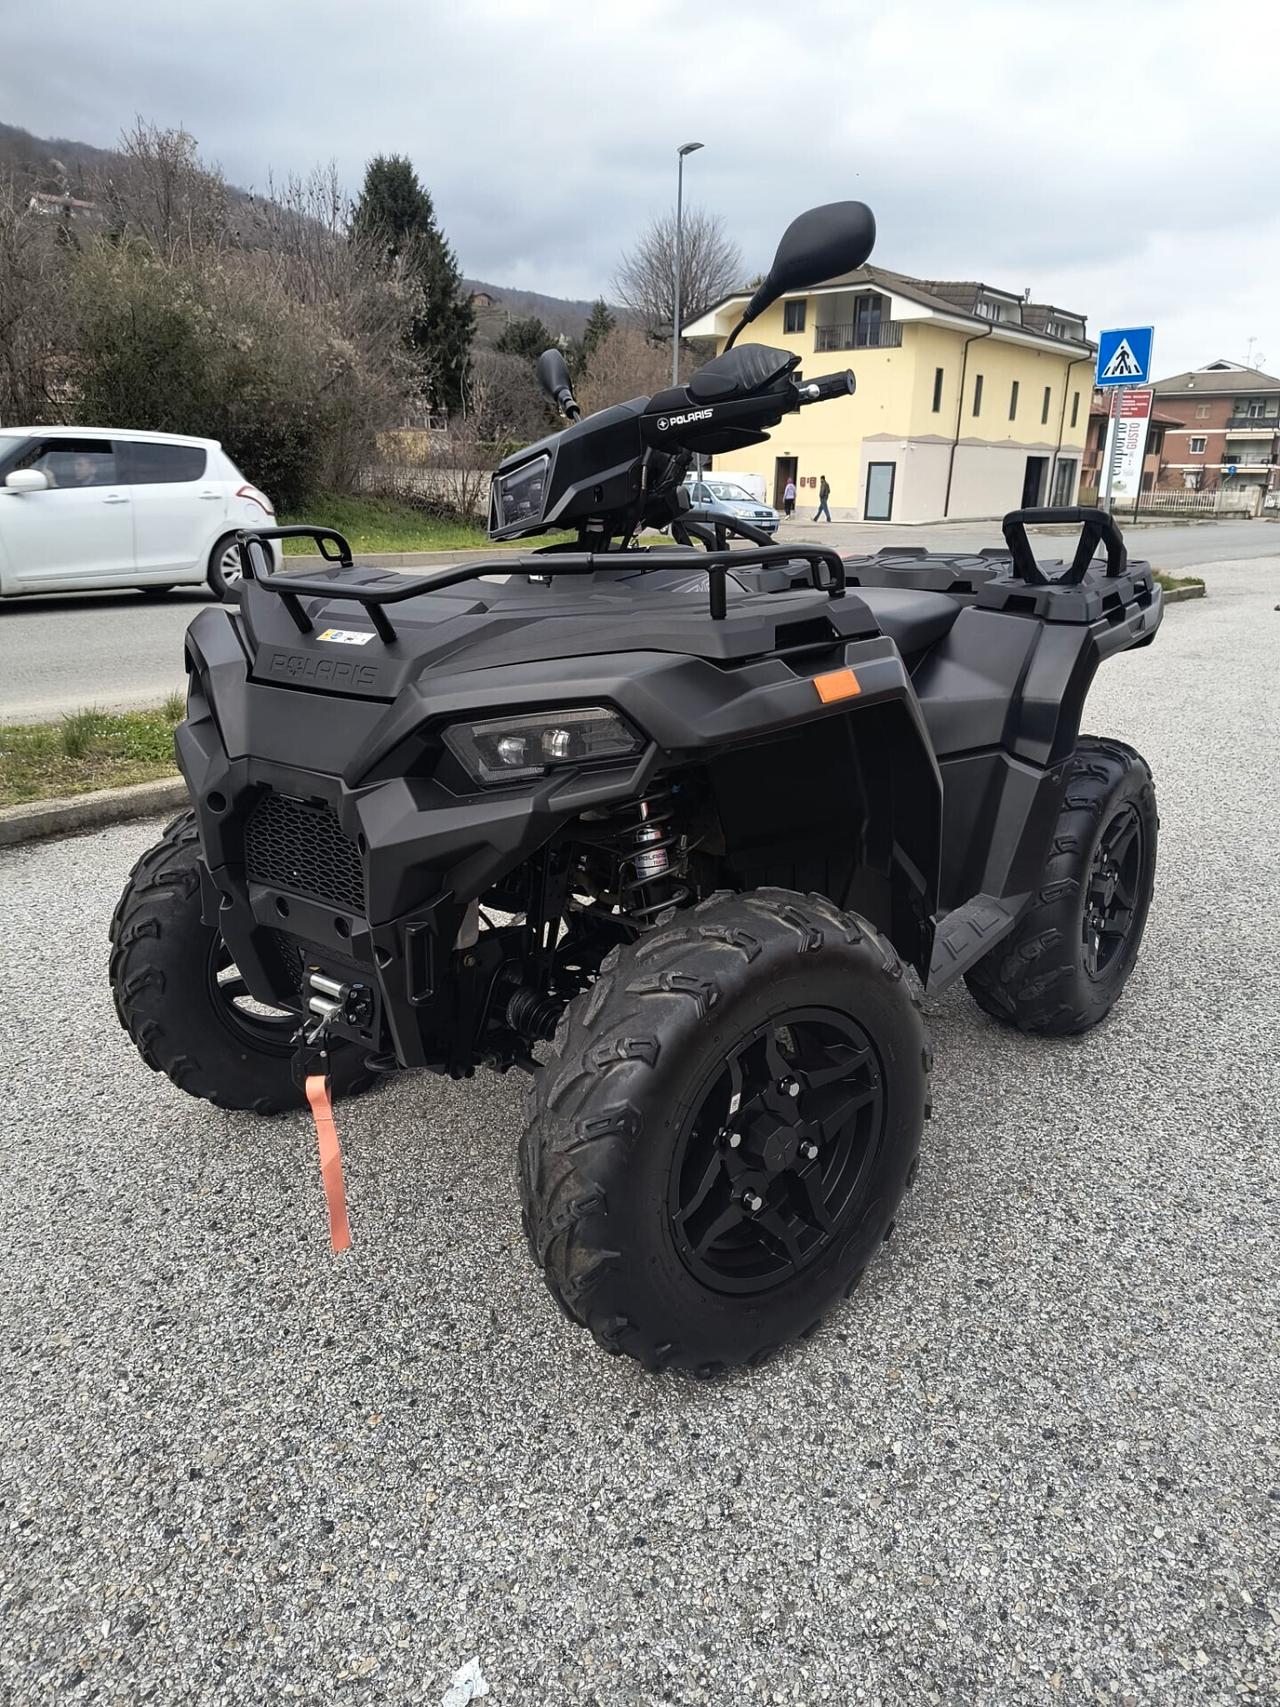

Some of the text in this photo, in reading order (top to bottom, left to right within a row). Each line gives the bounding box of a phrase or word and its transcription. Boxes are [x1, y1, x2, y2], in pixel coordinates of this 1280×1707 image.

[669, 408, 714, 426] POLARIS
[1126, 422, 1141, 450] GUSTO
[271, 653, 379, 685] POLARIS
